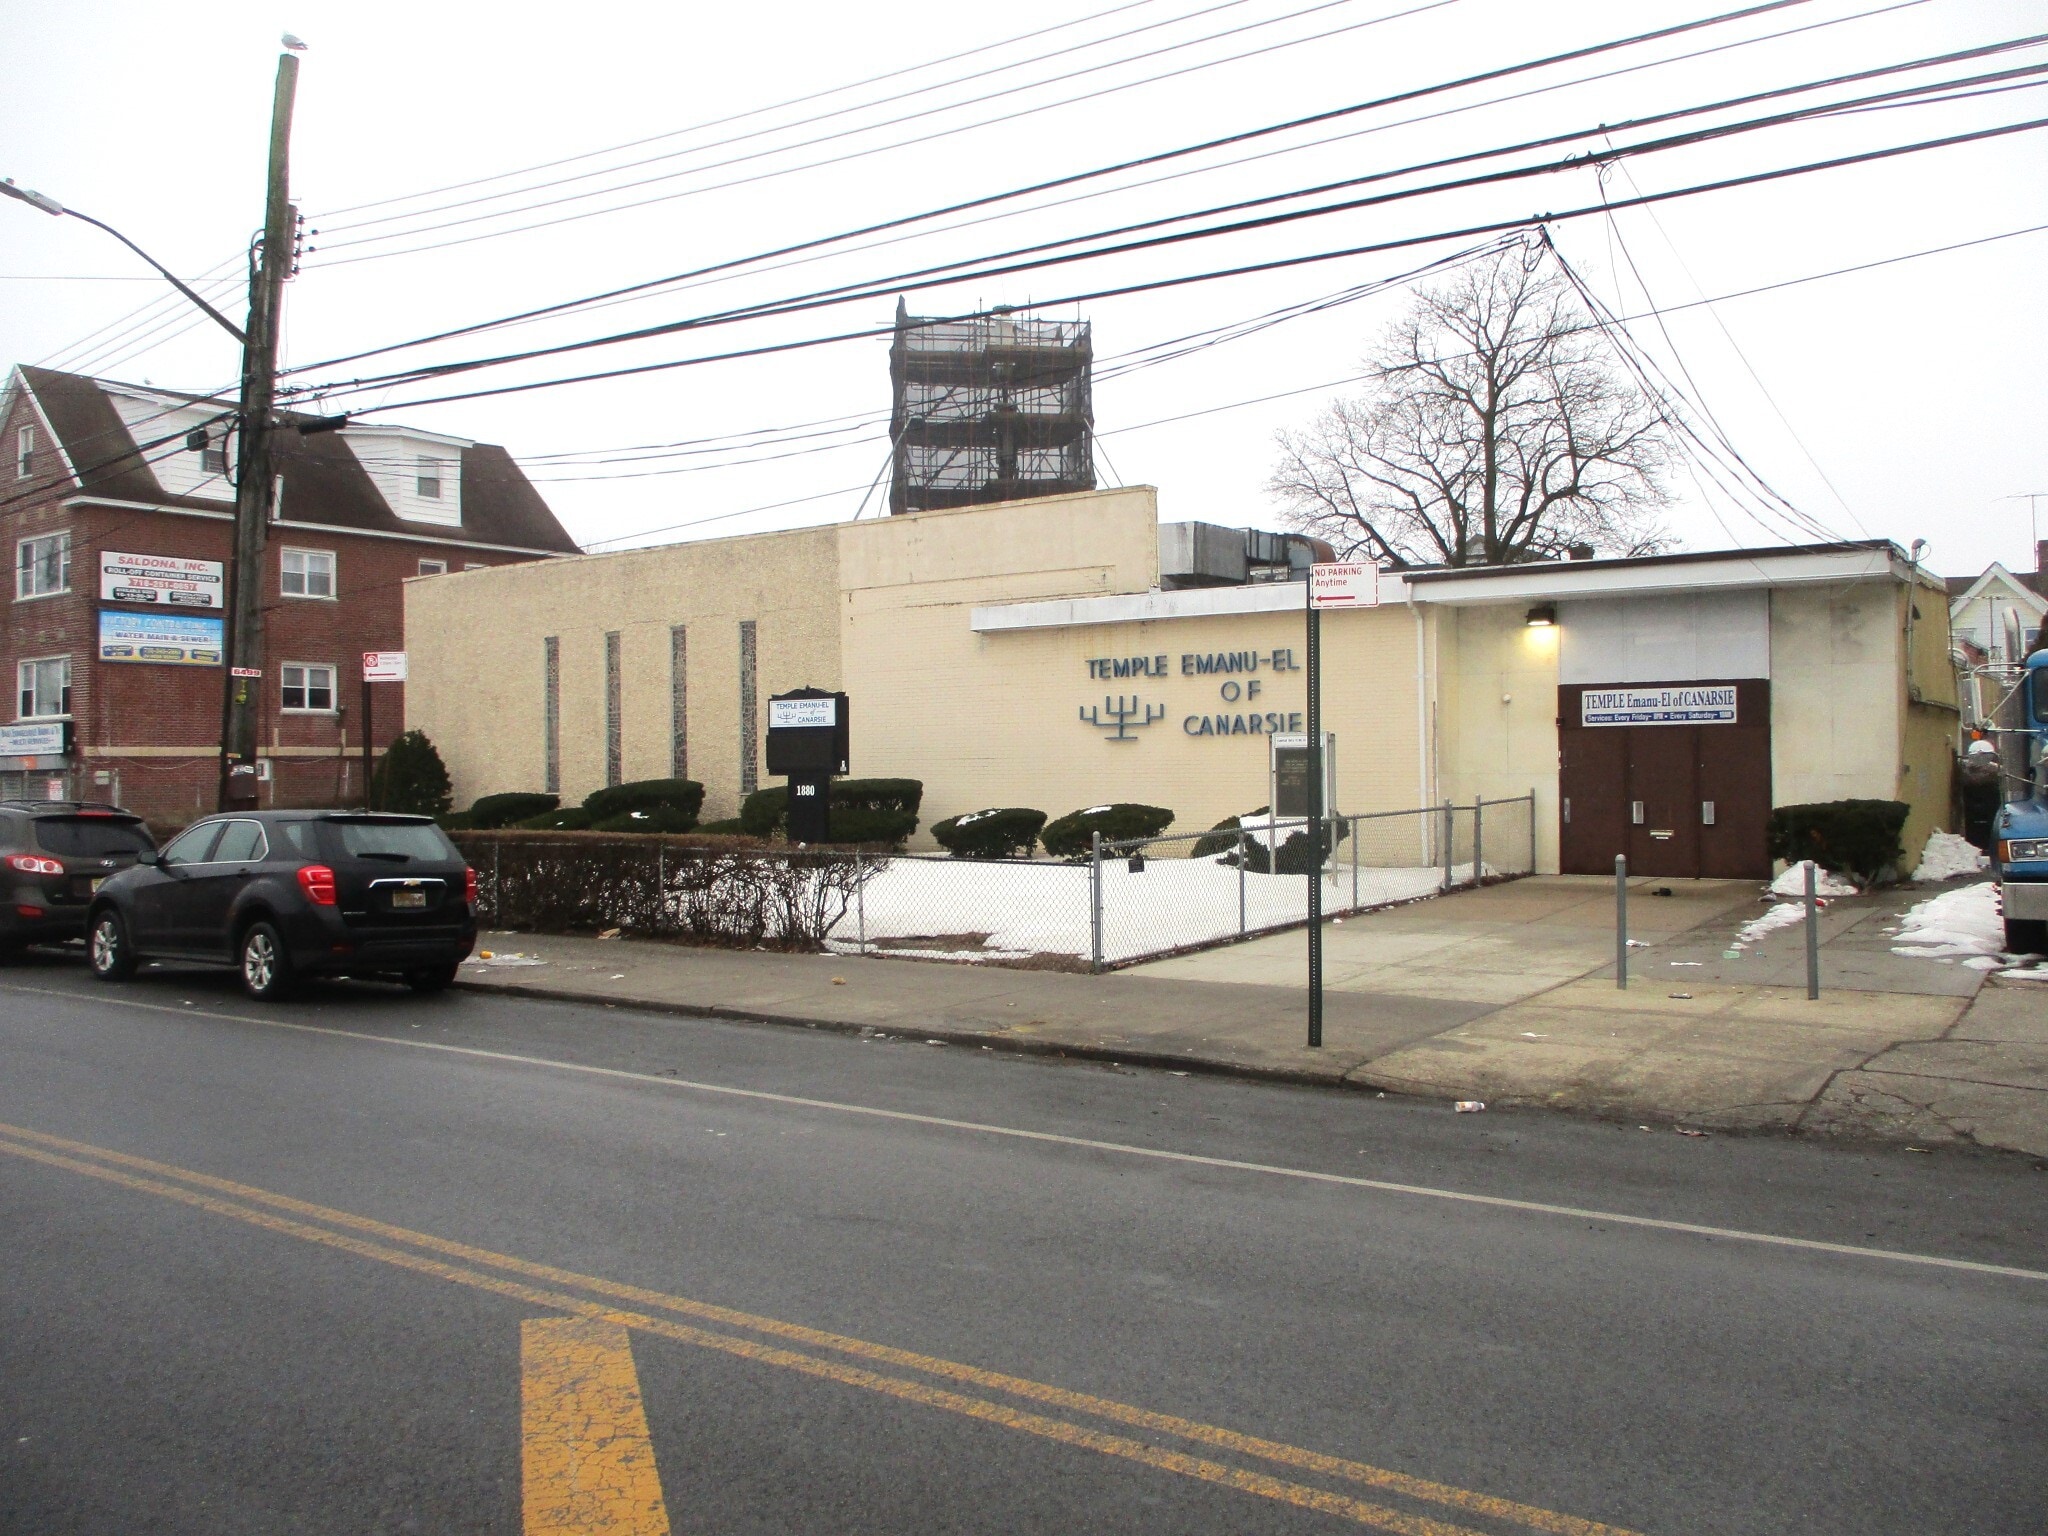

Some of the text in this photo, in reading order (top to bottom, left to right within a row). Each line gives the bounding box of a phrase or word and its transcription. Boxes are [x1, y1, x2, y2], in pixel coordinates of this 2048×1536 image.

[118, 556, 208, 572] SALDONA, INC.
[107, 567, 218, 583] ROLL-OFF CONTAINER SERVICE
[1315, 567, 1362, 577] NO PARKING
[1315, 578, 1348, 588] Anytime
[115, 631, 144, 639] WATER
[147, 633, 169, 641] MAIN
[180, 635, 210, 643] SEWER
[1085, 648, 1300, 680] TEMPLE EMANU-EL
[1220, 680, 1261, 702] OF
[799, 701, 829, 709] EMANU-EL
[1585, 690, 1734, 709] TEMPLE Emanu-El of CANARSIE
[1183, 712, 1302, 736] CANARSIE
[1587, 714, 1612, 722] Services:
[1614, 714, 1630, 722] Every
[1669, 712, 1686, 720] Every
[796, 785, 815, 796] 1880
